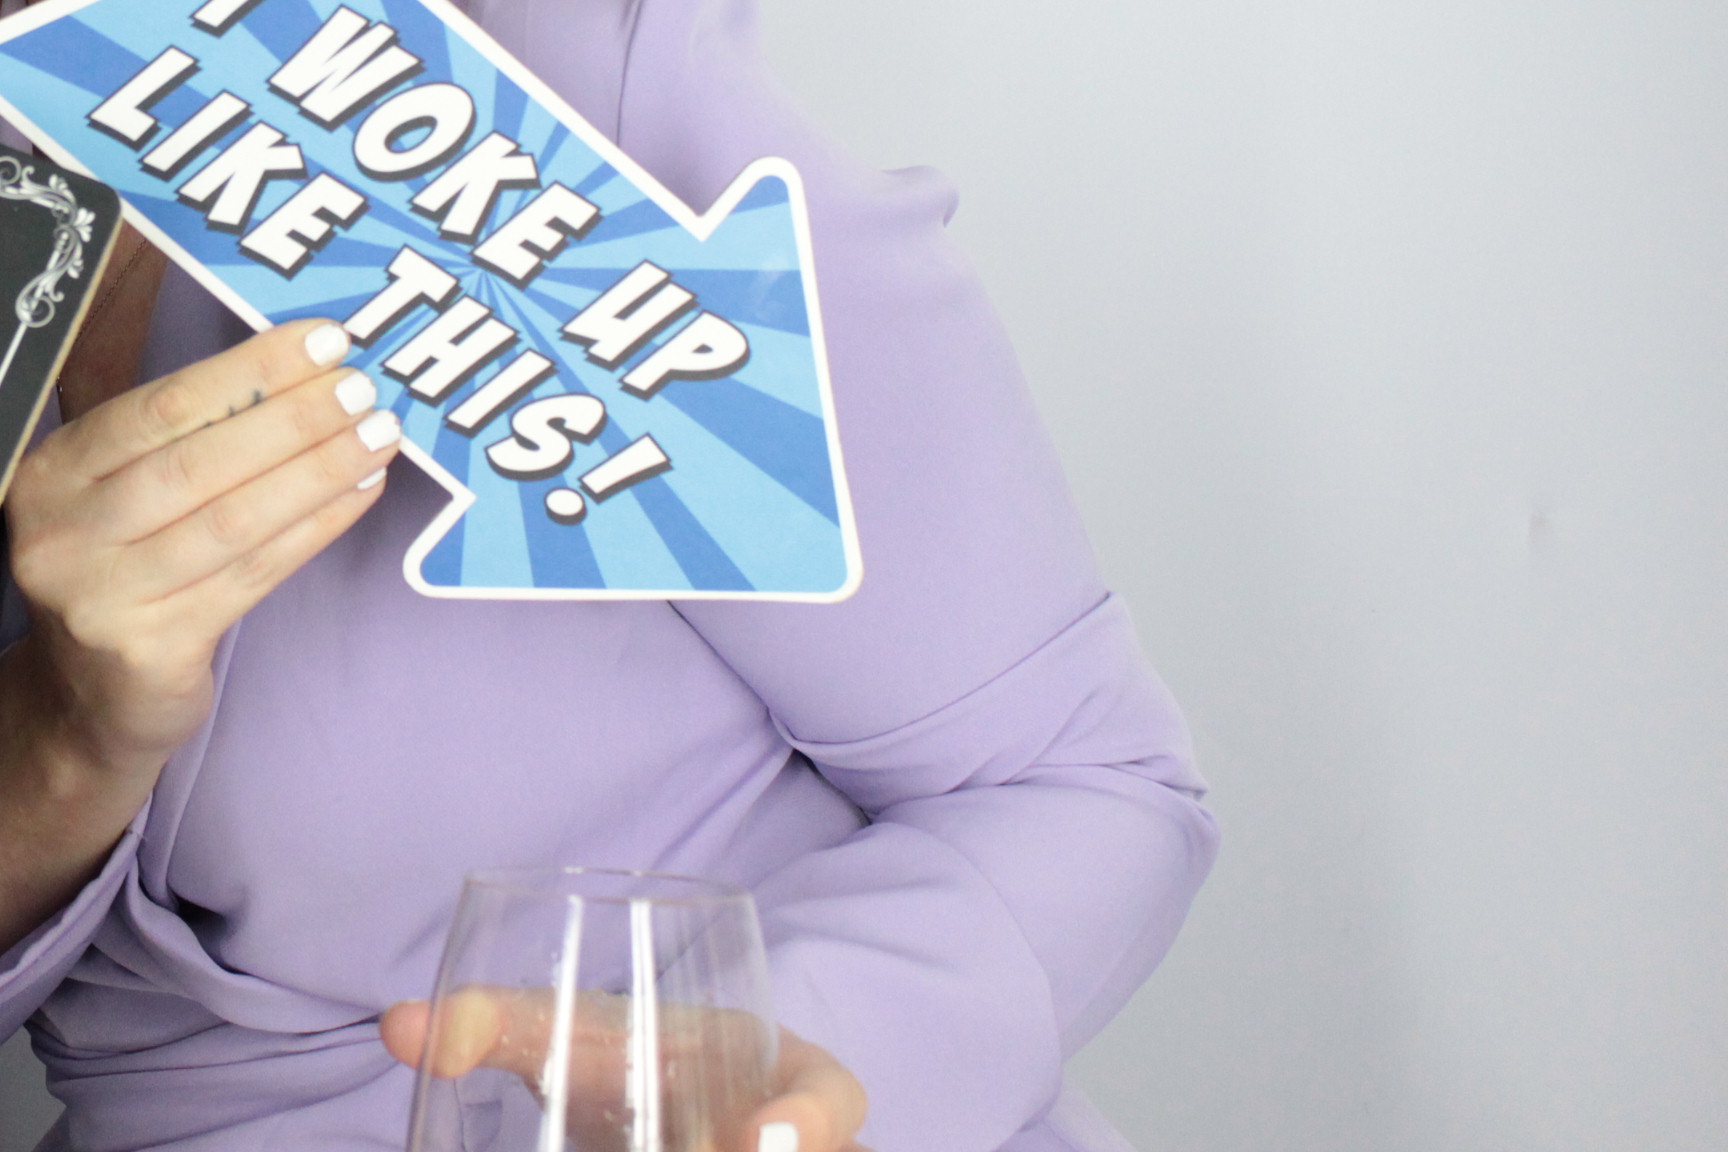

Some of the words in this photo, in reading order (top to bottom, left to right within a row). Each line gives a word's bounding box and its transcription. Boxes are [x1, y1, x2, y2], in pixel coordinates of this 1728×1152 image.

[85, 44, 370, 282] LIKE
[340, 244, 674, 526] THIS!
[266, 3, 602, 291] WOKE
[560, 258, 752, 401] UP
